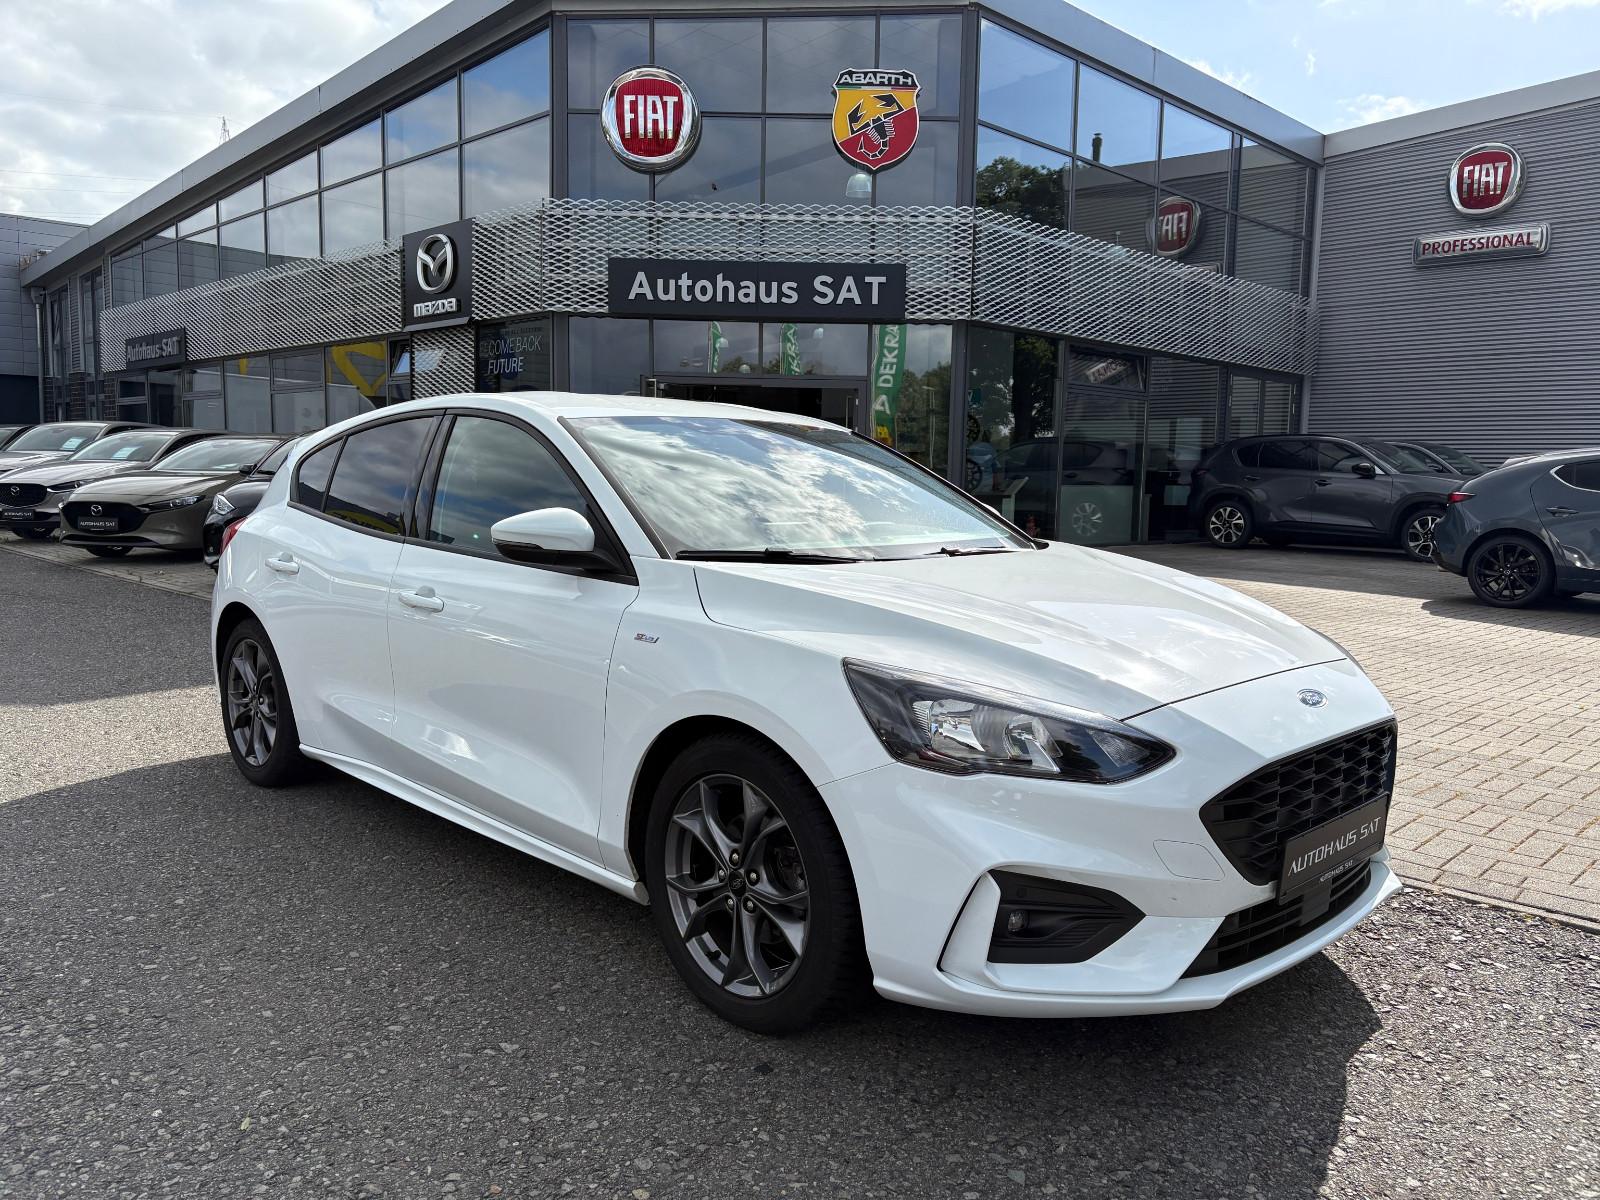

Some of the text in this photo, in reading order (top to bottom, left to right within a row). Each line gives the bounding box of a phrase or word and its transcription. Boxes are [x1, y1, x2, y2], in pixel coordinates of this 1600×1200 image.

[840, 72, 912, 86] ABARTH
[623, 94, 679, 140] FIAT
[1462, 161, 1508, 198] FIAT
[1421, 231, 1535, 256] PROFESSIONAL
[627, 271, 887, 306] Autohaus SAT
[126, 336, 179, 363] Autohaus SAT
[487, 356, 525, 375] FUTURE
[877, 324, 901, 388] DEKRA
[1287, 816, 1382, 877] AUTOHAUS SAT
